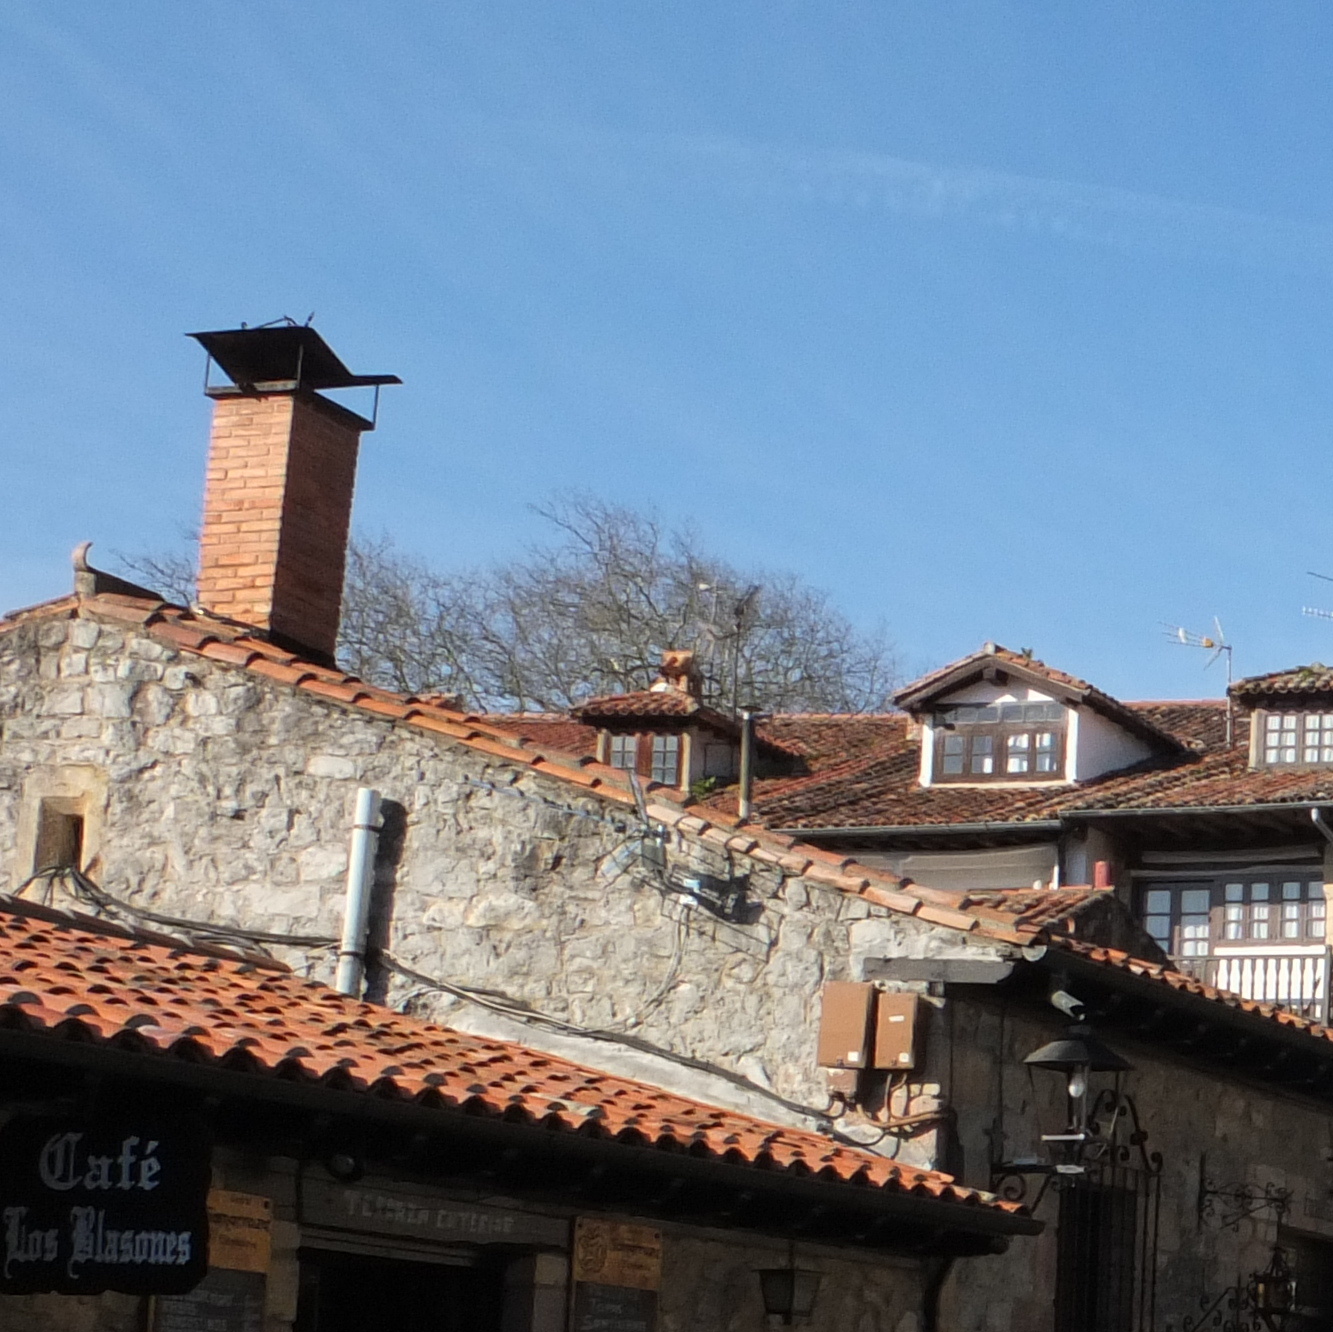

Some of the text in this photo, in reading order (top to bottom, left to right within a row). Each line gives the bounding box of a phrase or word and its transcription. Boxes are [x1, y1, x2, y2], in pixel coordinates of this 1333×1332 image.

[39, 1131, 162, 1191] Café
[3, 1205, 192, 1279] Los Blasones
